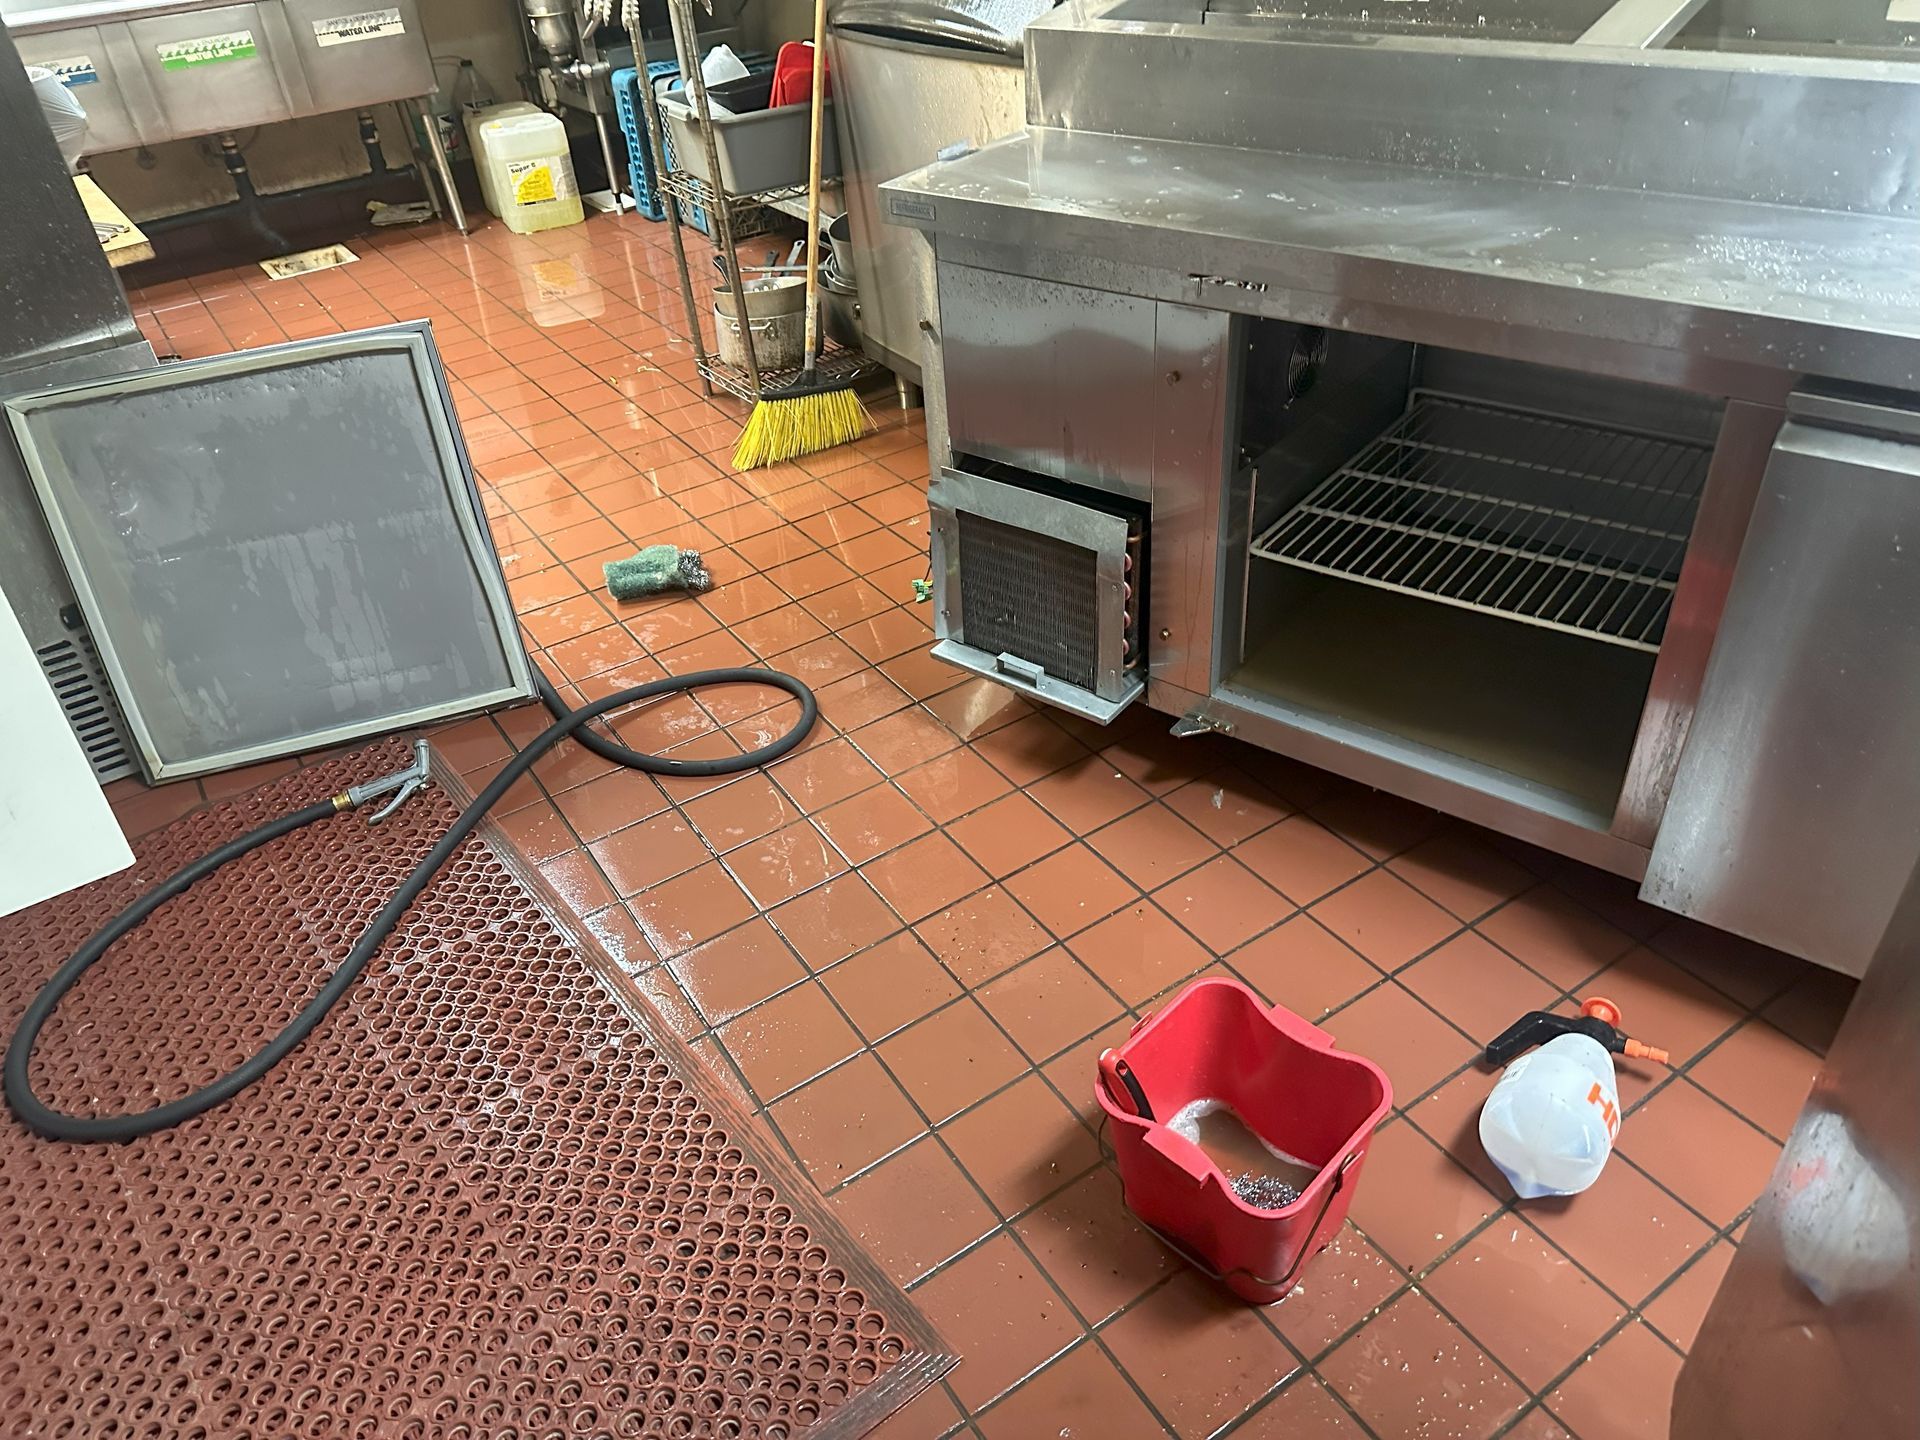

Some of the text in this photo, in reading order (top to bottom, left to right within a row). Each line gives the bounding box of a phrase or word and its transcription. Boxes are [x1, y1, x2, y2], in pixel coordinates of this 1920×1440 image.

[337, 24, 382, 38] WATER LINE
[185, 48, 233, 62] WATER LINE
[511, 165, 529, 174] Super
